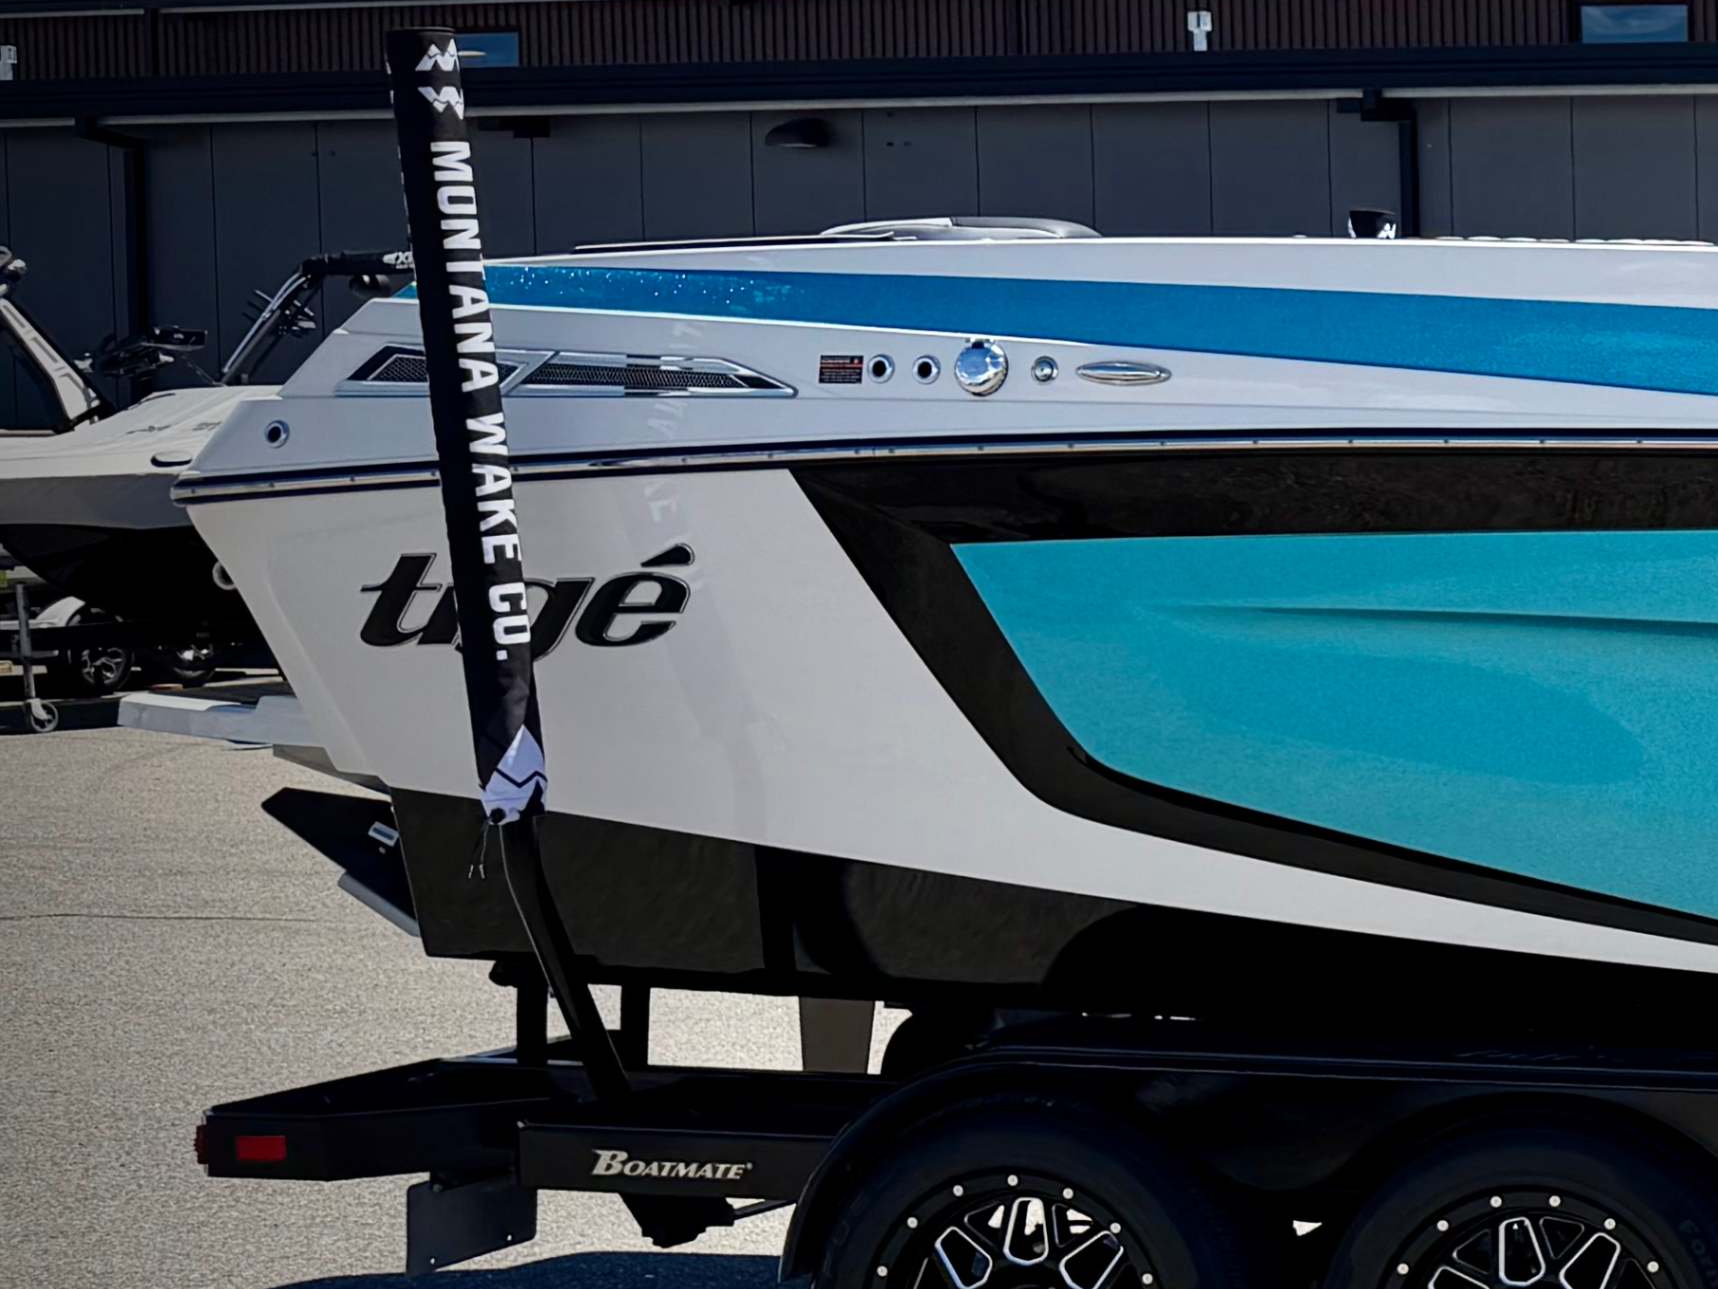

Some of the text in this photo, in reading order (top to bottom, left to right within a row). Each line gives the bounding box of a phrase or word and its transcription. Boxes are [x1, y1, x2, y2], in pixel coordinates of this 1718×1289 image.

[430, 141, 532, 661] MONTANA WAKE CO.
[591, 1149, 746, 1180] BOATMATE
